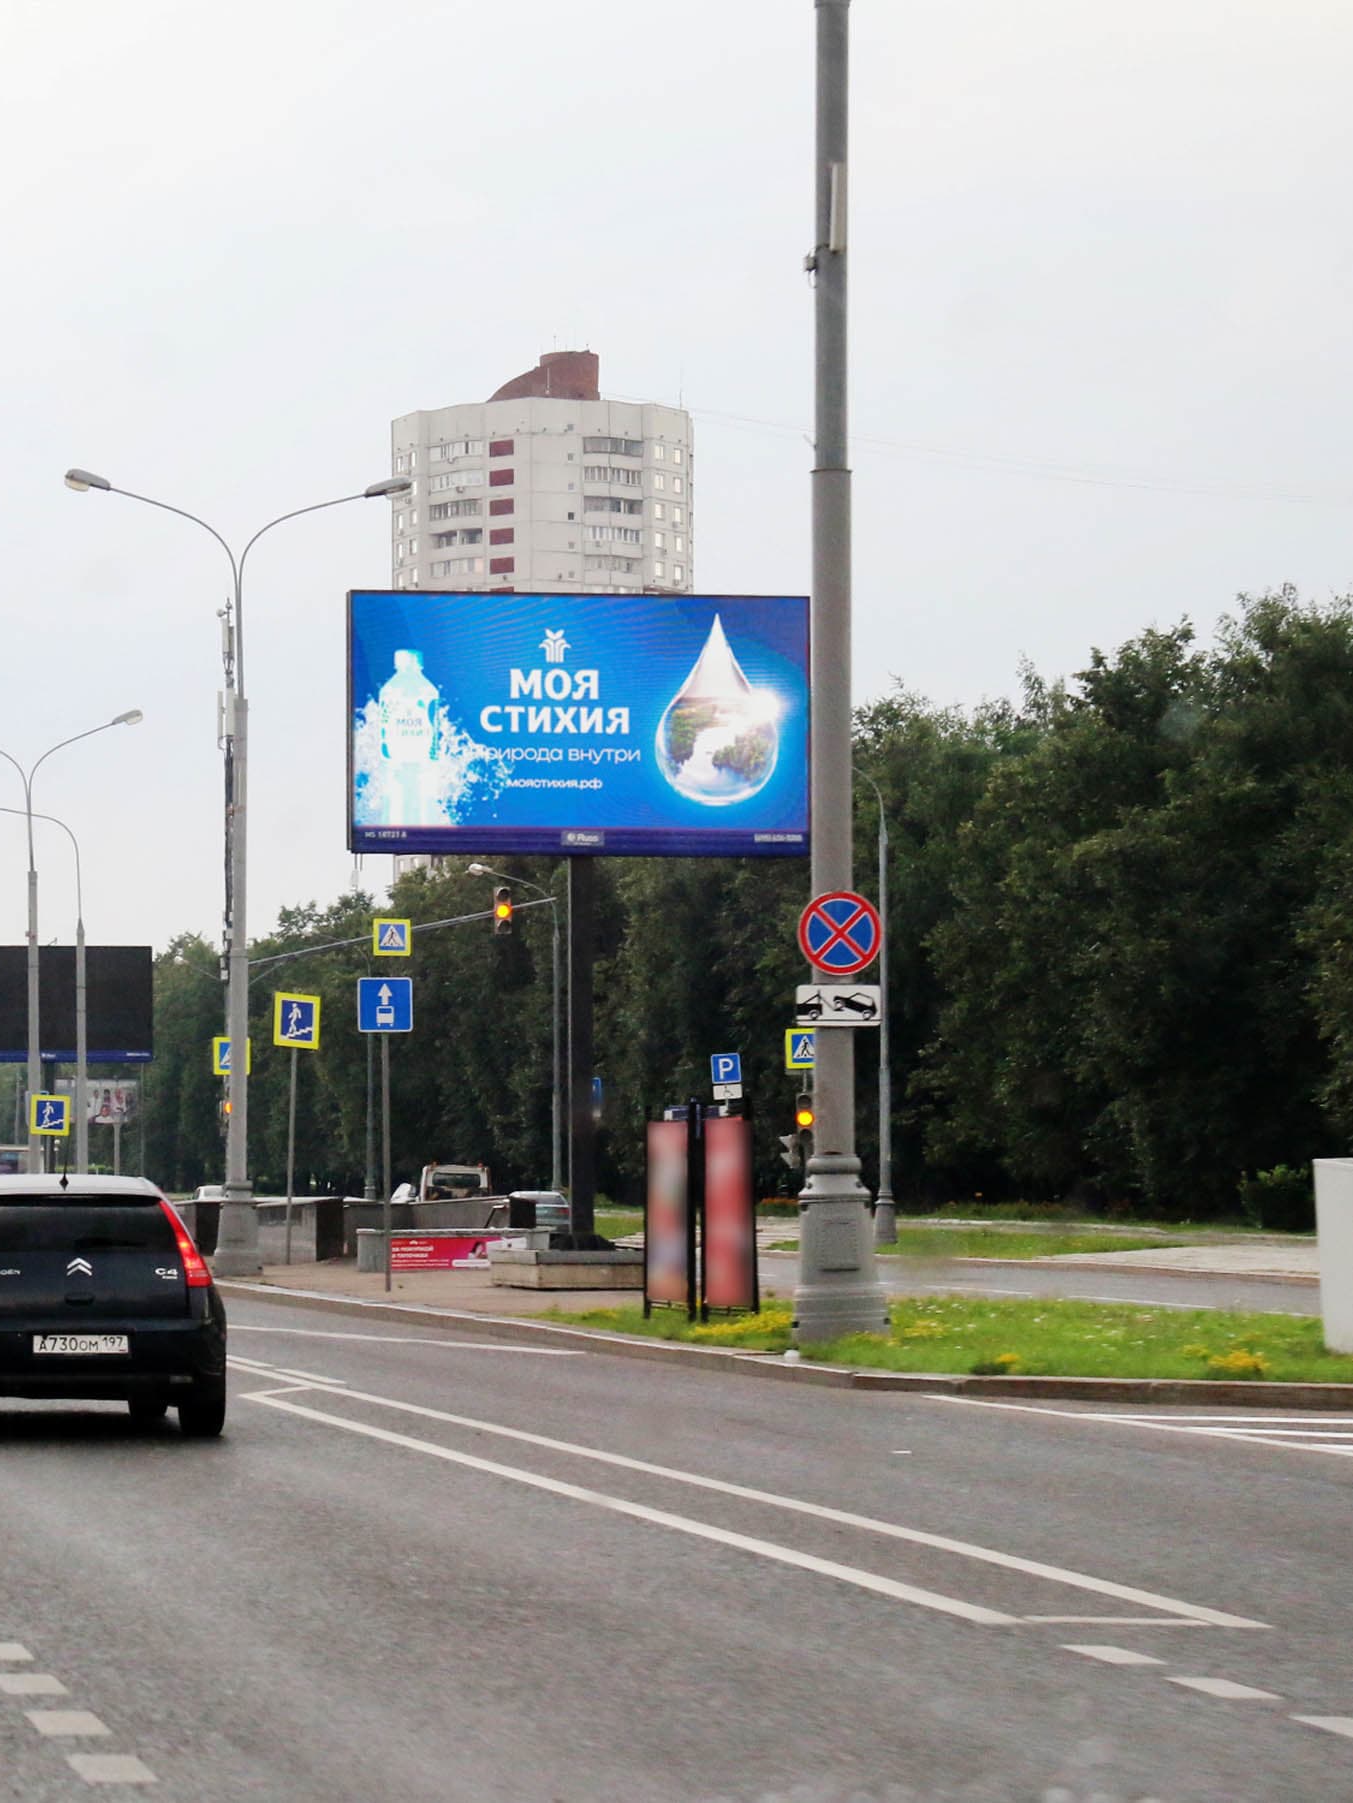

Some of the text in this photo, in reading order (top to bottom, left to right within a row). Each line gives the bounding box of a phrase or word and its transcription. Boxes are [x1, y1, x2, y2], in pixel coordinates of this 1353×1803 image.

[509, 668, 599, 701] МОЯ
[479, 705, 630, 735] СТИХИЯ
[475, 747, 641, 765] рирода внутри
[718, 1057, 734, 1080] P
[154, 1267, 179, 1277] C4
